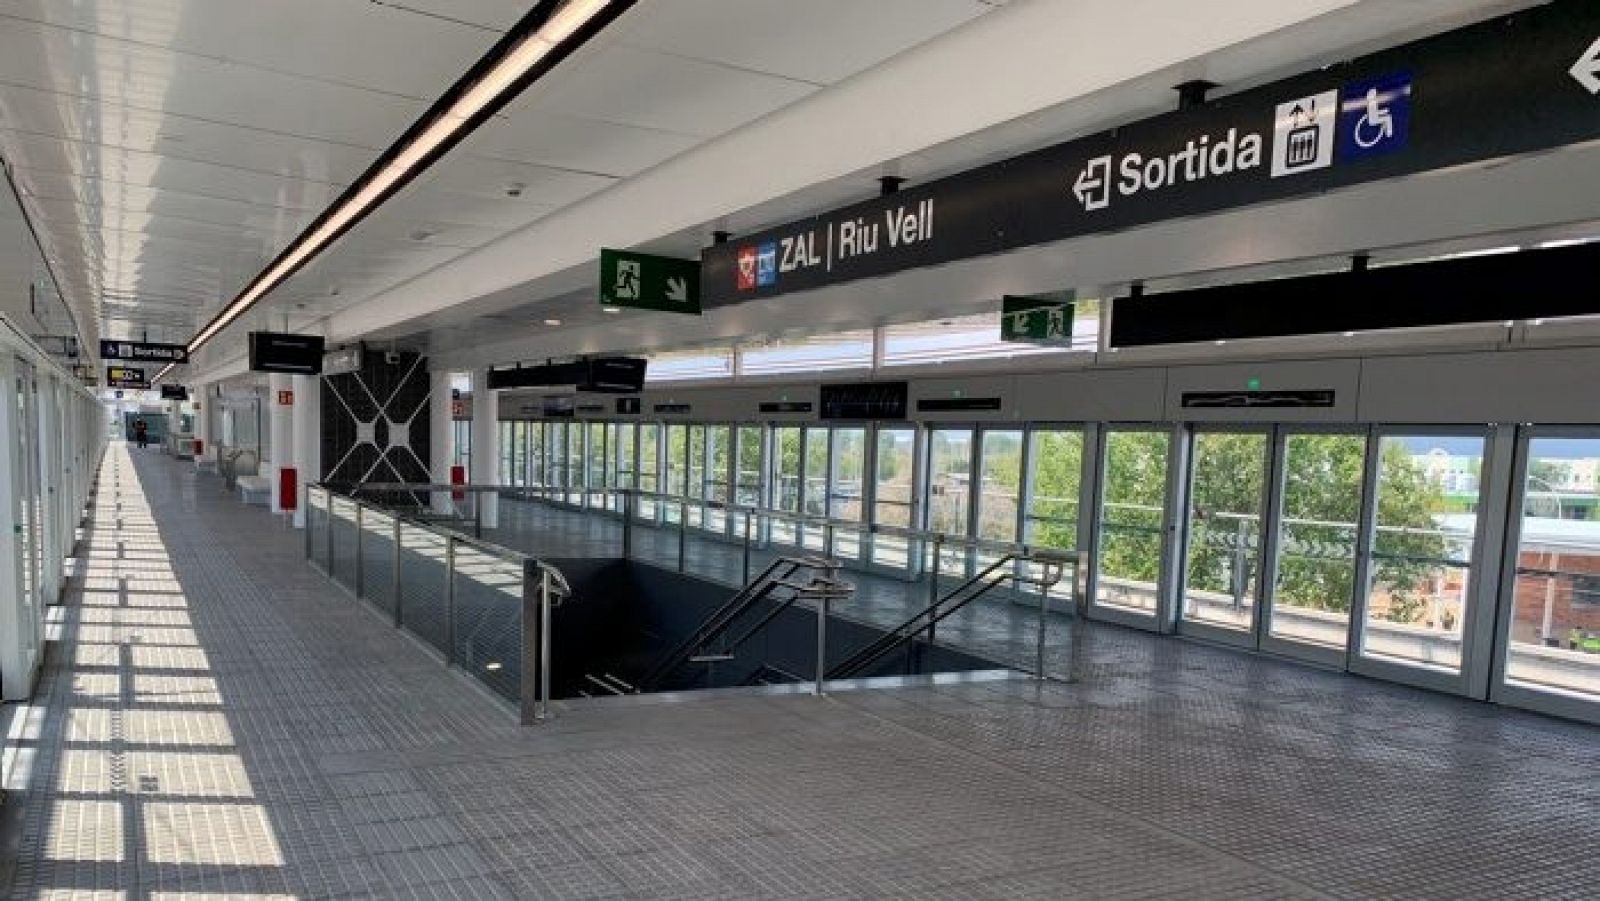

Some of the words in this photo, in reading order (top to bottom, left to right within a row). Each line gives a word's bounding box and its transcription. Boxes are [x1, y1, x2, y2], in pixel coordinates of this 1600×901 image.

[1118, 127, 1263, 195] Sortida
[778, 230, 821, 273] ZAL
[838, 216, 879, 260] Riu
[885, 198, 934, 248] Vell
